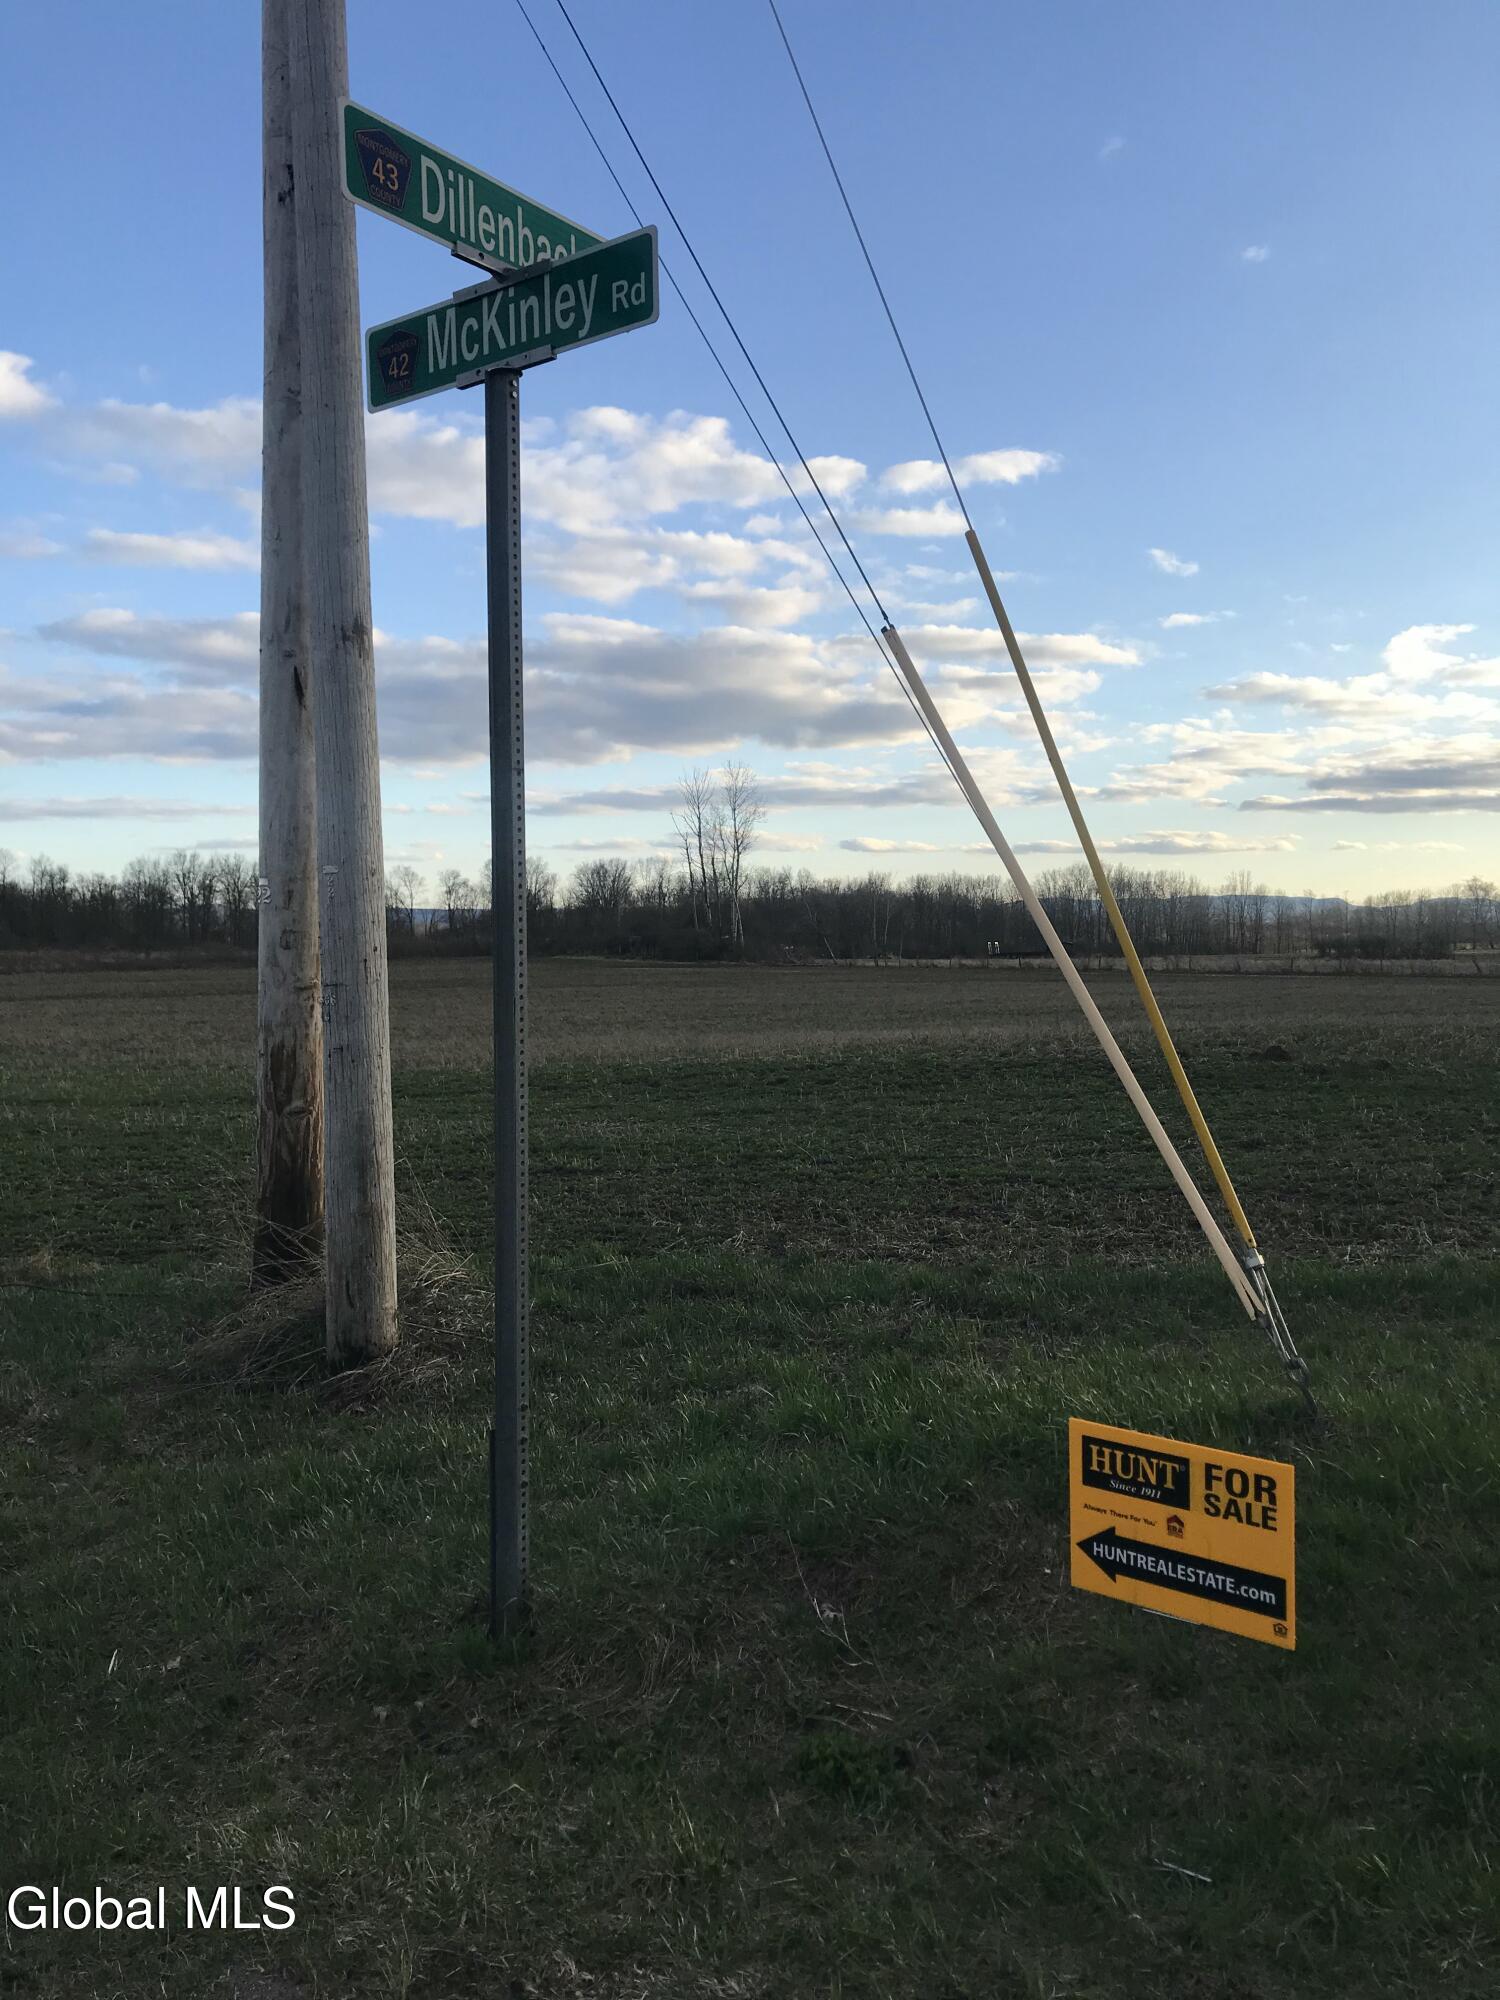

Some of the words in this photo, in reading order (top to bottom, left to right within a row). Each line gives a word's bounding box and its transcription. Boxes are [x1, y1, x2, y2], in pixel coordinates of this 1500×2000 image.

[372, 158, 399, 191] 43
[427, 273, 598, 373] McKinley
[610, 271, 646, 312] Rd
[389, 352, 409, 378] 42
[1109, 1480, 1137, 1493] Since
[1141, 1487, 1161, 1499] 1911
[1204, 1462, 1277, 1506] FOR
[1204, 1493, 1277, 1532] SALE
[1093, 1541, 1276, 1605] HUNTREALESTATE.com
